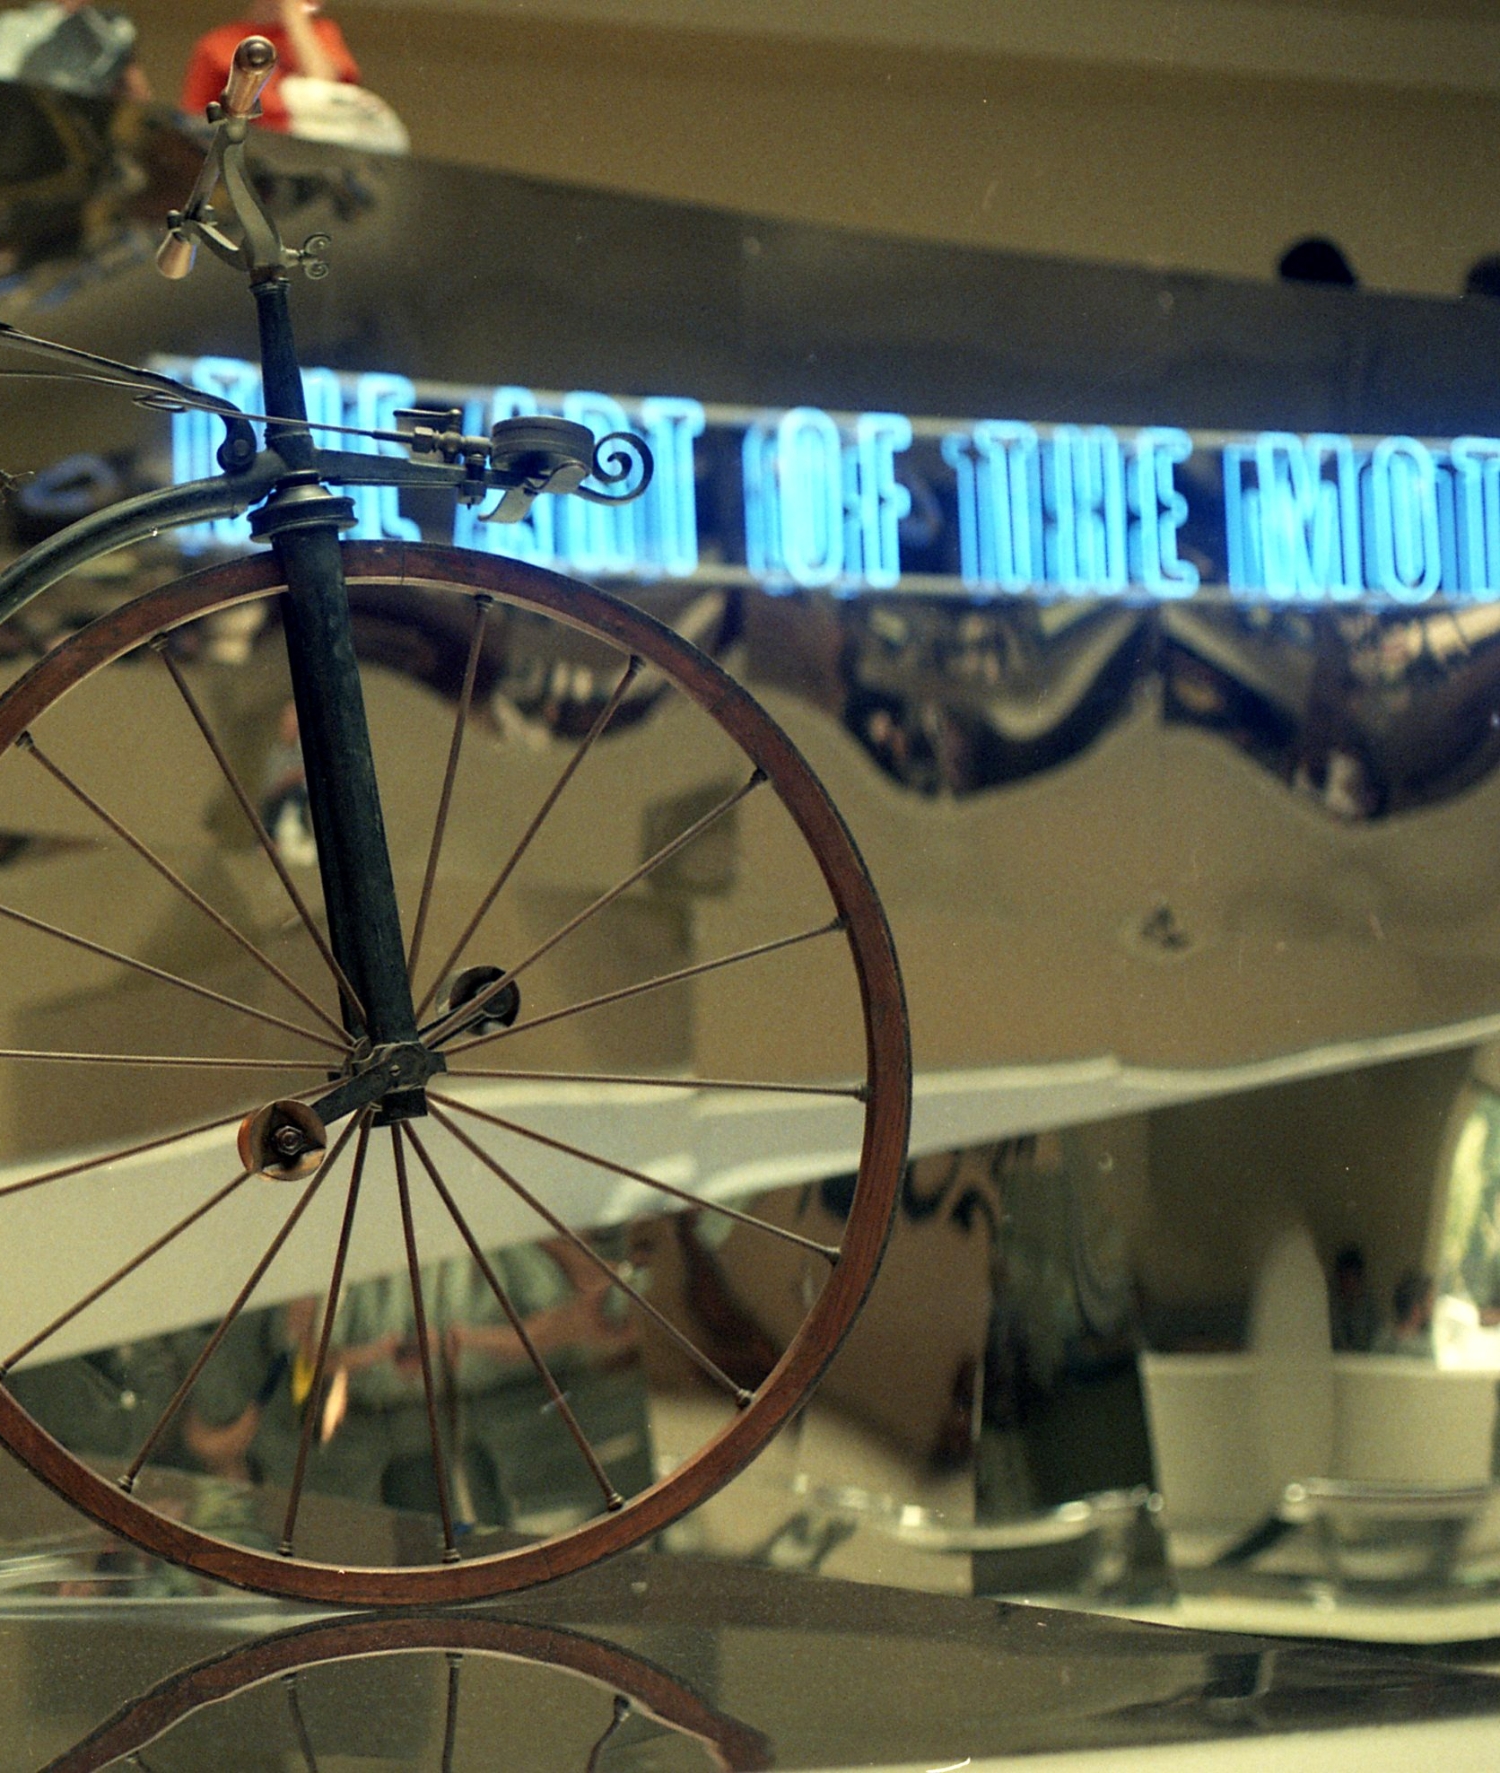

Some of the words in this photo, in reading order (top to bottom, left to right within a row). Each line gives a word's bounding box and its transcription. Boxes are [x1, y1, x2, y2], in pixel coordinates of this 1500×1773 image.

[170, 356, 422, 562] TE
[743, 406, 912, 595] OF
[942, 419, 1200, 602] THE
